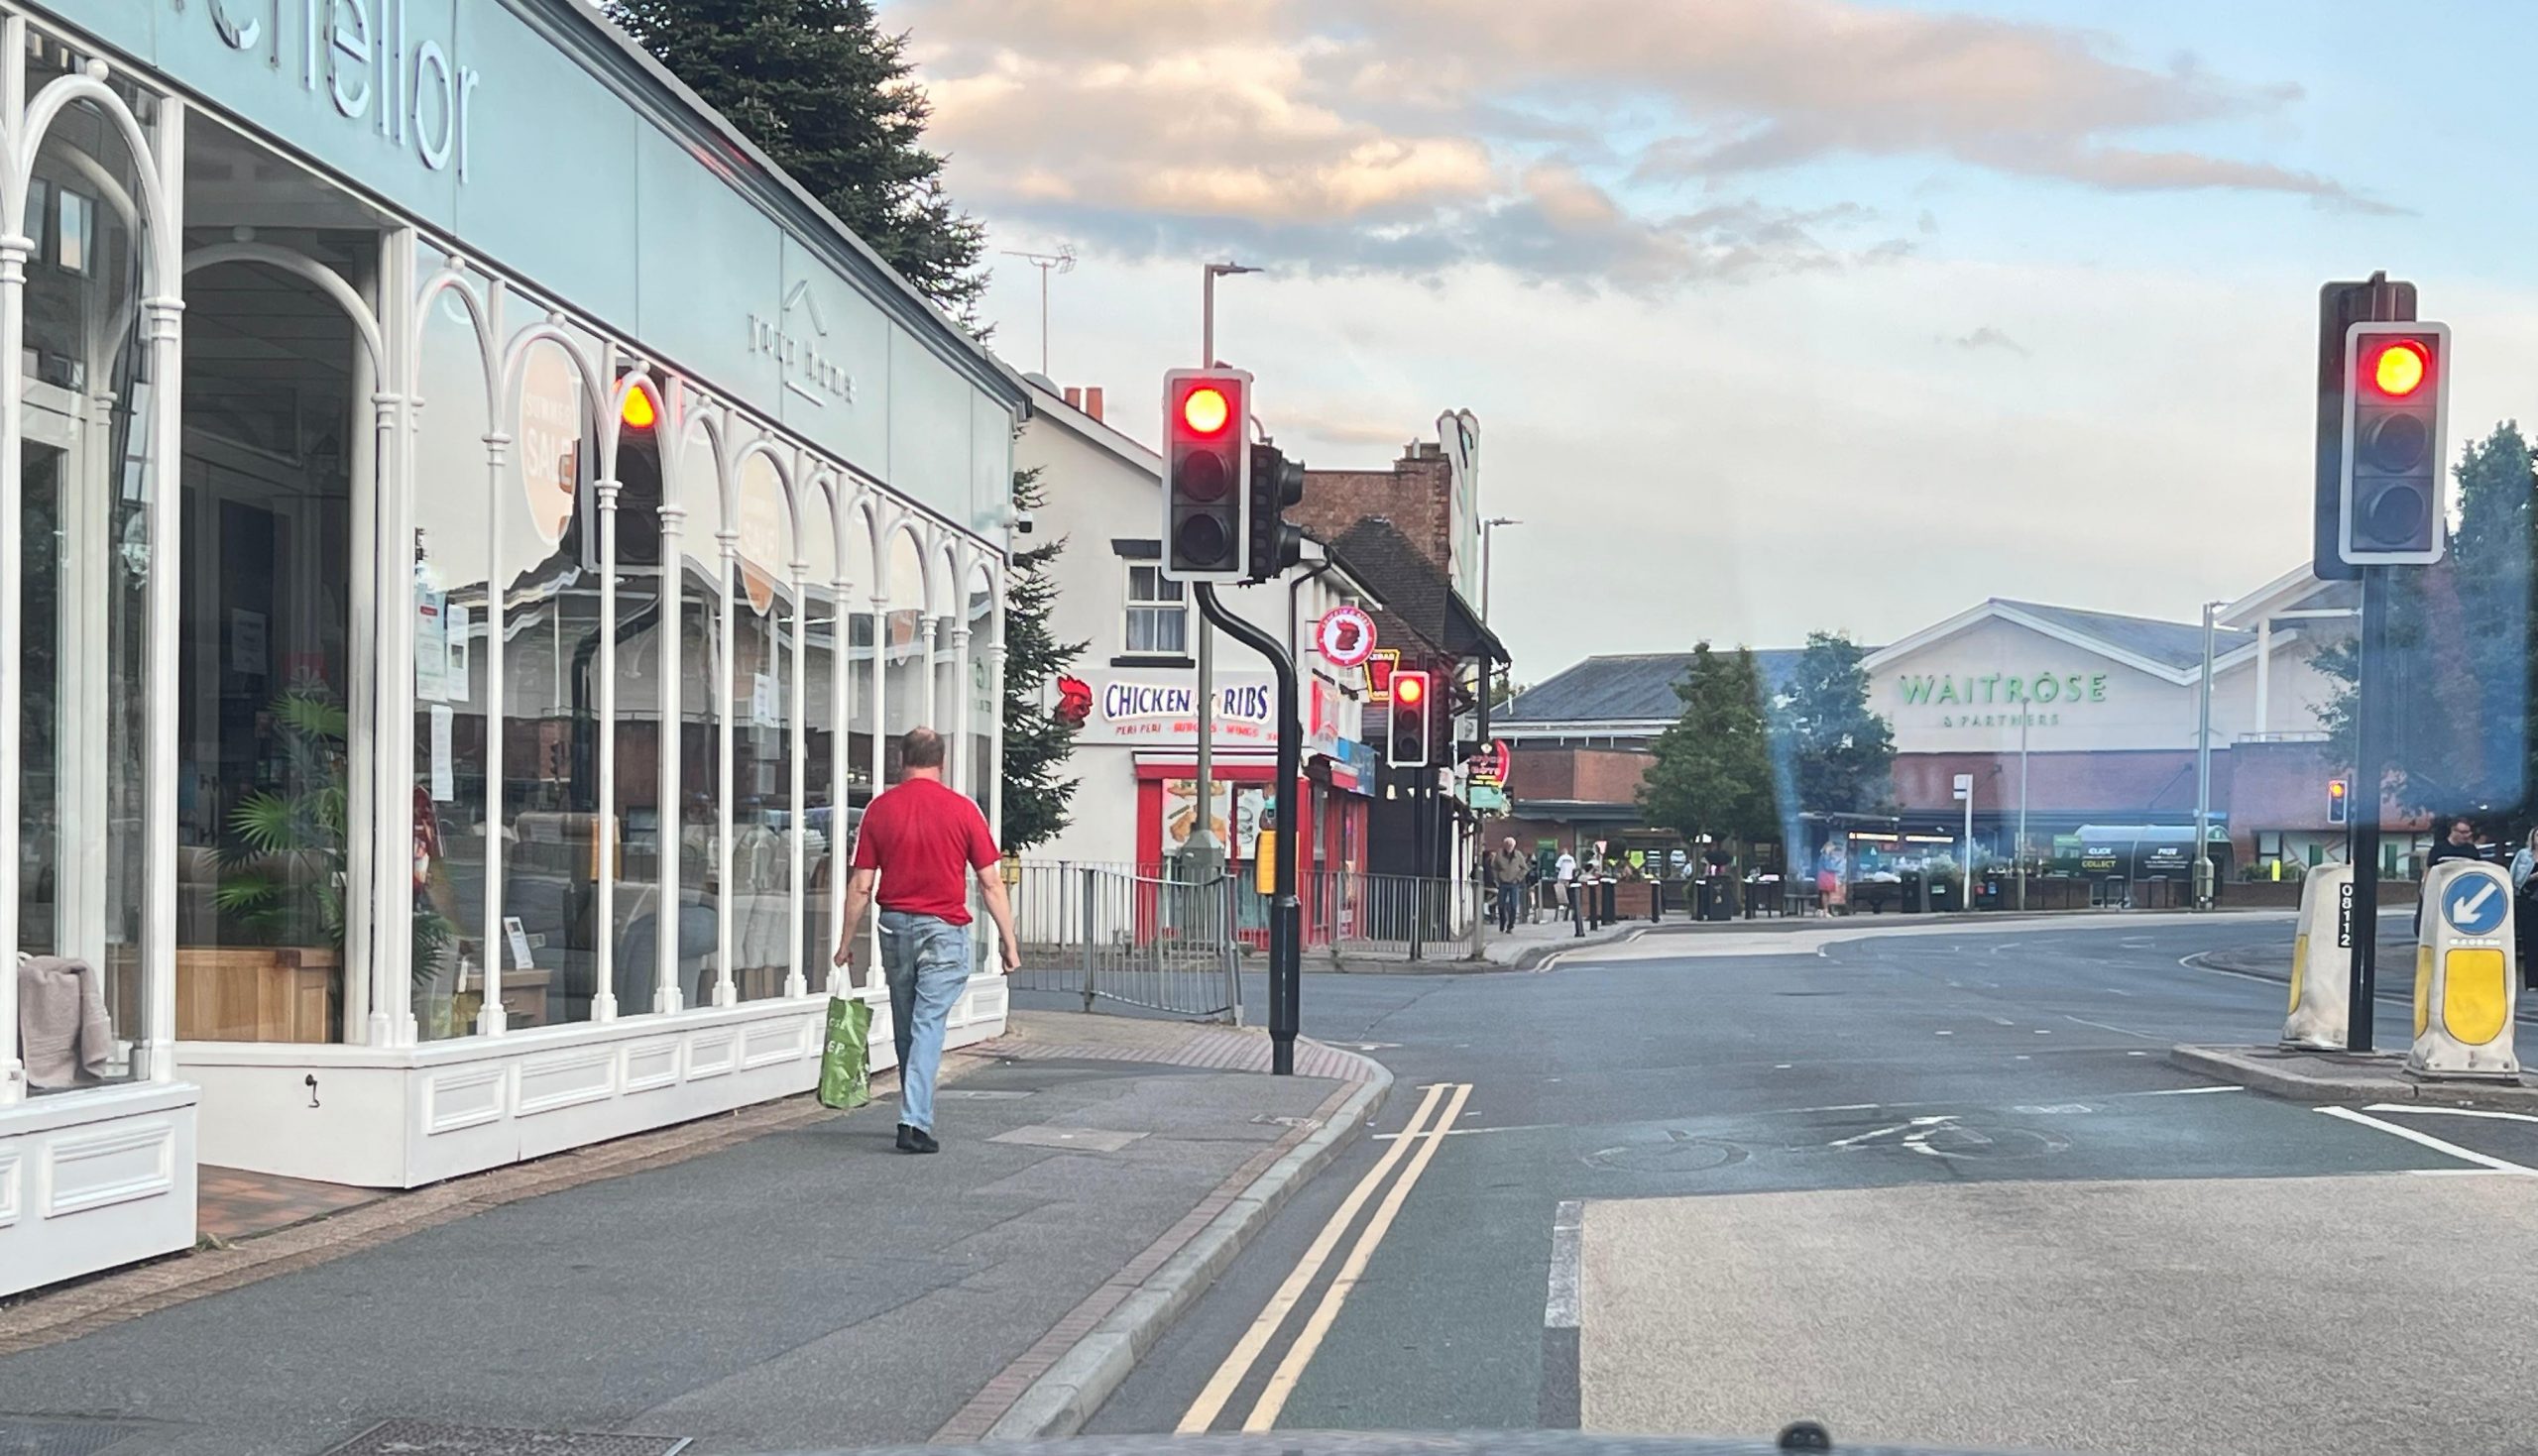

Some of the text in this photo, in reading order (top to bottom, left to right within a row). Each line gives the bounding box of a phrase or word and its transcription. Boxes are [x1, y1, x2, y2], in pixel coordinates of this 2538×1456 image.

[171, 0, 480, 187] ellor
[526, 427, 574, 489] SALE
[1105, 684, 1192, 719] CHICKEN
[1223, 684, 1269, 721] RIBS
[1899, 672, 2108, 706] WAITROSE
[1115, 725, 1137, 735] PERI
[1140, 723, 1161, 734] PERI
[1226, 724, 1259, 738] WINGS
[1960, 714, 2060, 727] PARTNERS
[2341, 883, 2354, 947] 08112
